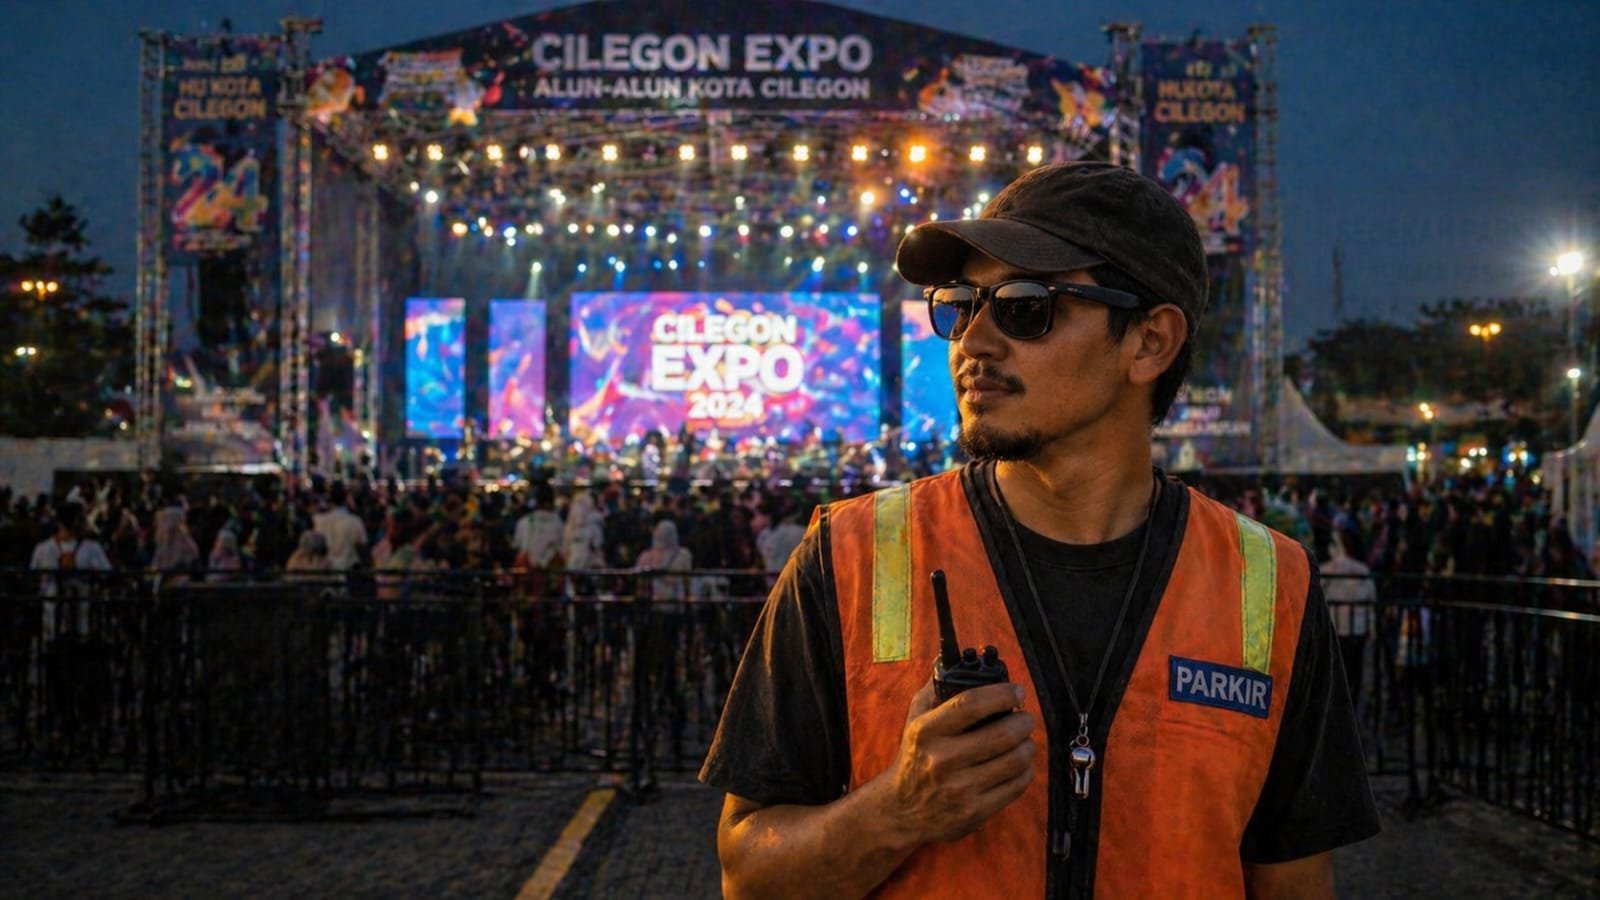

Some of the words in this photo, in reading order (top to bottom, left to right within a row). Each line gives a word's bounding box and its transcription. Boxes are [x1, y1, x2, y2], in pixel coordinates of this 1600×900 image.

[533, 33, 731, 72] CILEGON
[744, 34, 873, 72] EXPO
[533, 77, 681, 98] ALUN-ALUN
[687, 77, 754, 98] KOTA
[760, 78, 871, 98] CILEGON
[173, 98, 267, 120] CILEGON
[1154, 101, 1246, 123] CILEGON
[653, 313, 797, 344] CILEGON
[651, 343, 805, 393] EXPO
[688, 392, 764, 419] 2024
[1176, 665, 1267, 710] PARKIR
